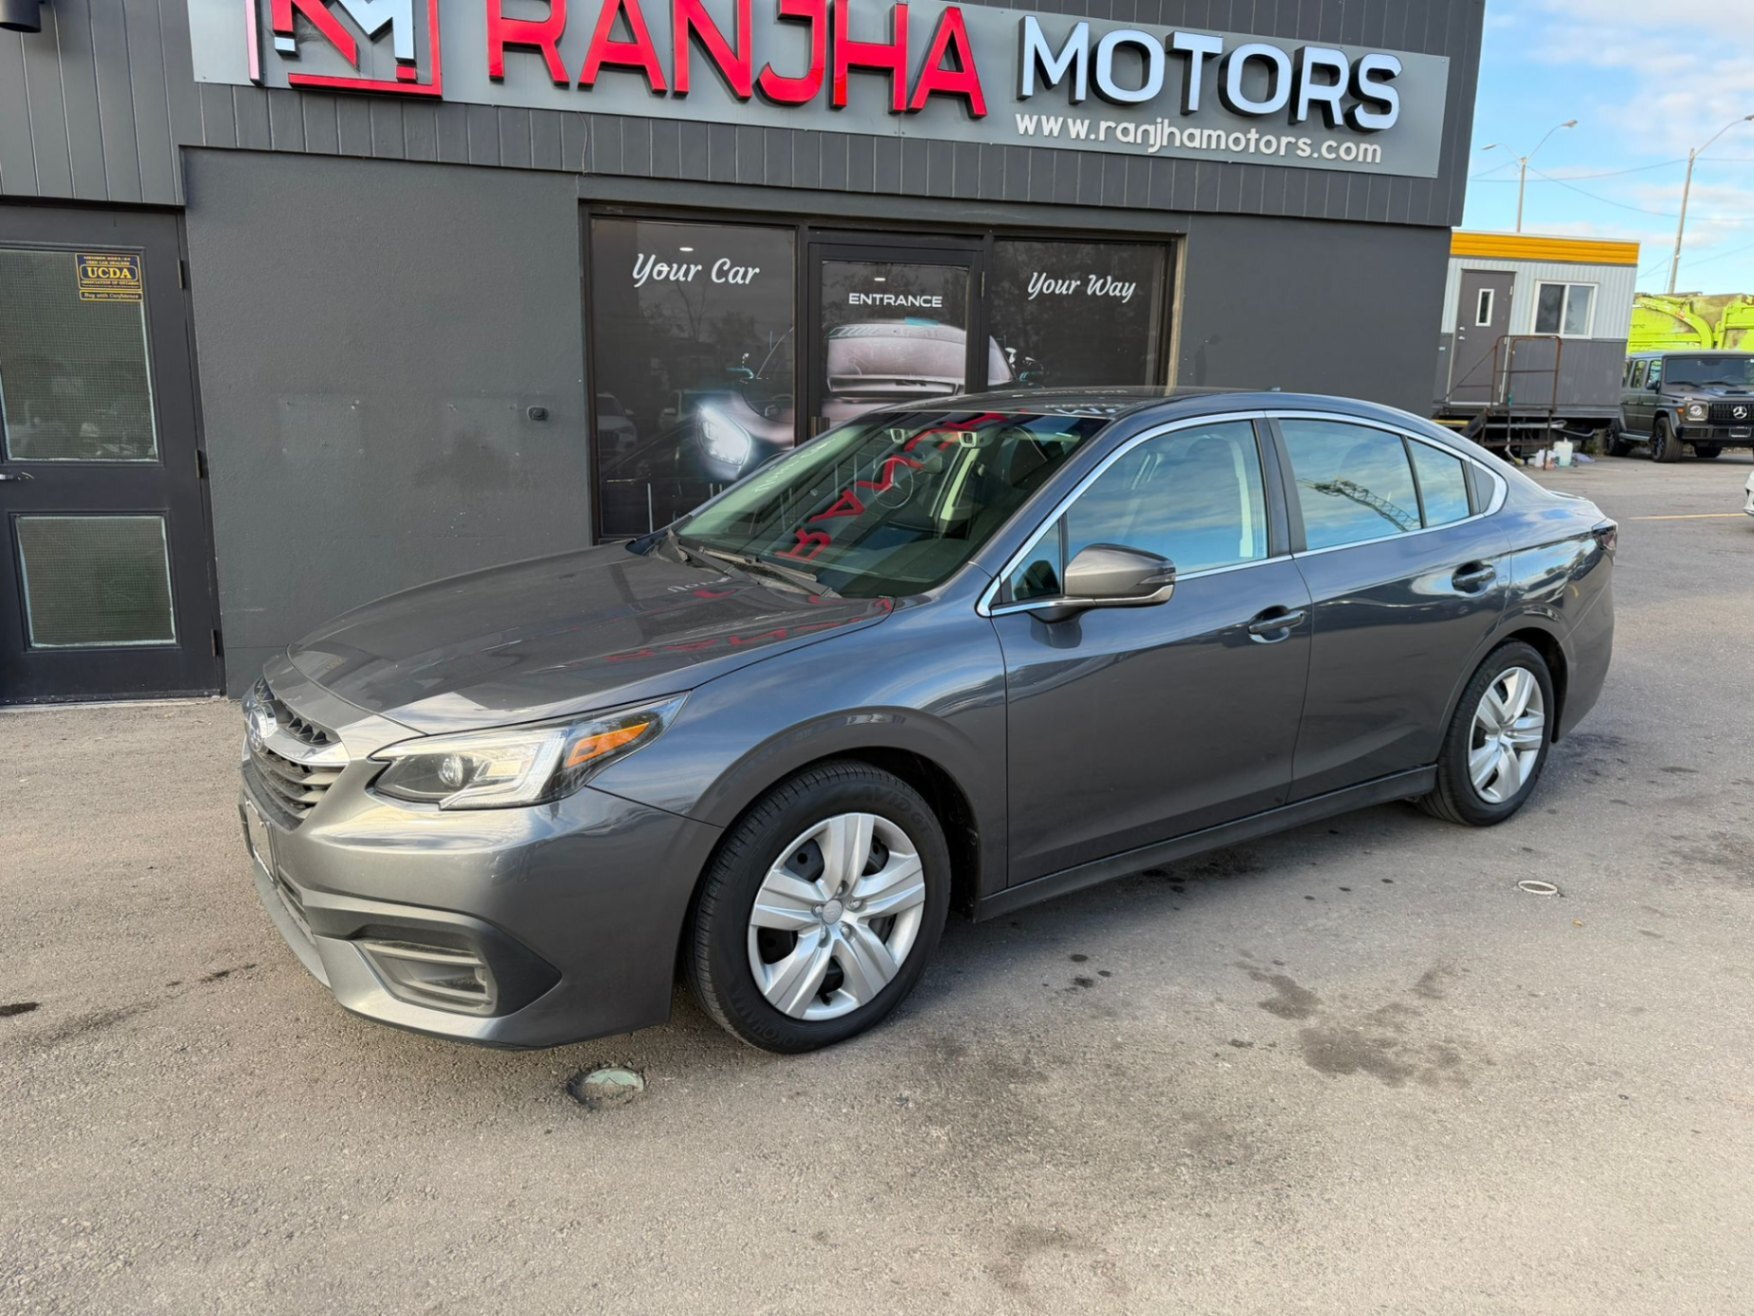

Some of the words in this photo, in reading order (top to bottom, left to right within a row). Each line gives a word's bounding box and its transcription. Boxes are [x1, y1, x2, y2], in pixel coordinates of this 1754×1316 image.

[488, 0, 987, 119] RANJHA
[1016, 15, 1402, 131] MOTORS
[1015, 113, 1383, 164] www.ranjhamotors.com
[86, 266, 133, 279] UCDA
[632, 252, 703, 288] Your
[710, 257, 760, 285] Car
[848, 292, 943, 308] ENTRANCE
[1027, 271, 1081, 300] Your
[1087, 274, 1137, 304] Way
